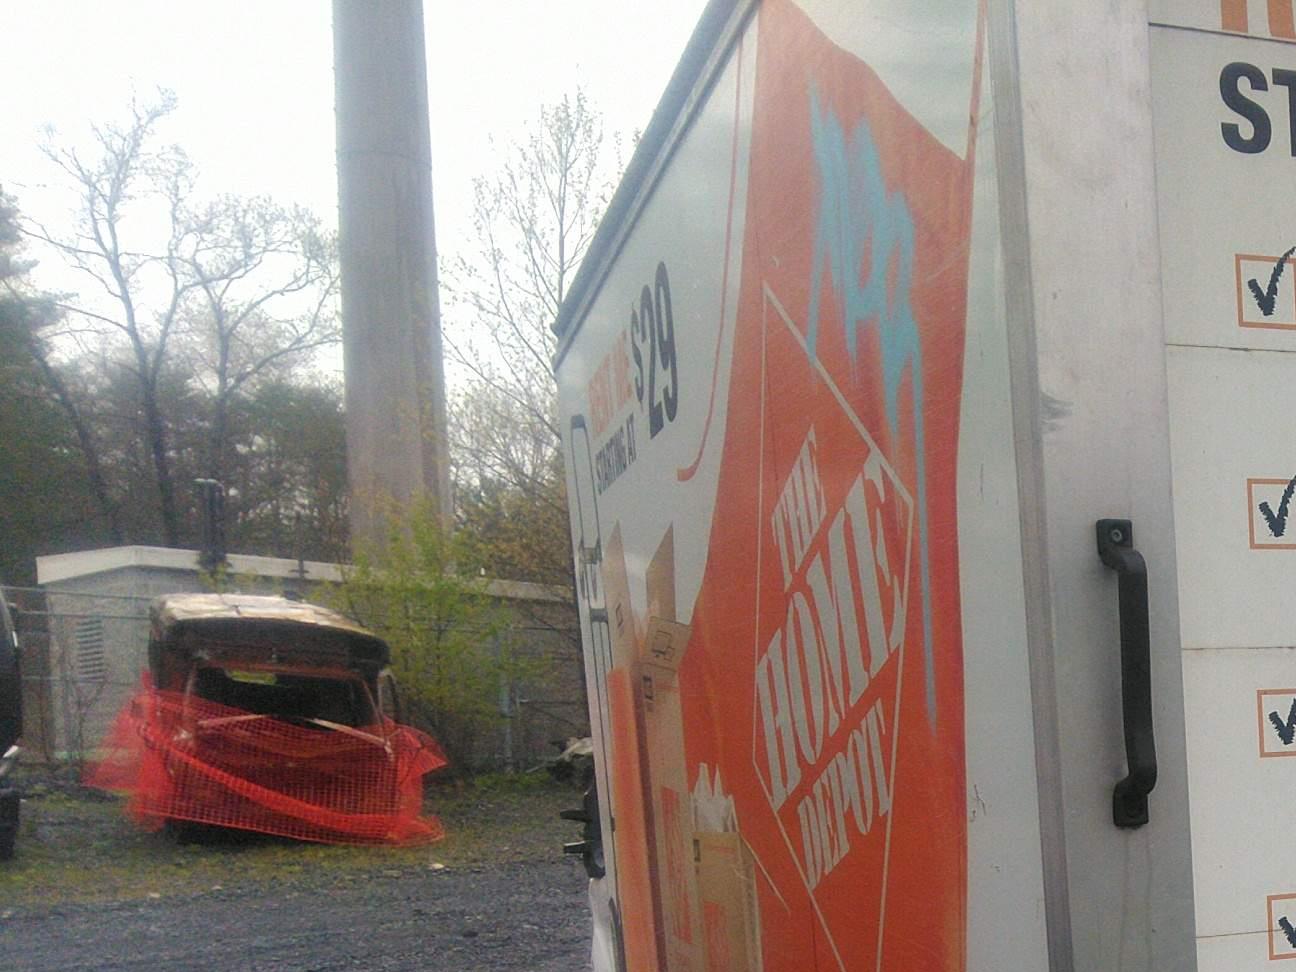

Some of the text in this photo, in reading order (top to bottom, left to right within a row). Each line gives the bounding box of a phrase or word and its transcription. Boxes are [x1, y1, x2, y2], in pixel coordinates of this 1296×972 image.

[630, 261, 678, 440] $29
[771, 423, 827, 594] THE
[757, 445, 903, 812] HOME
[798, 698, 891, 891] DEPOT
